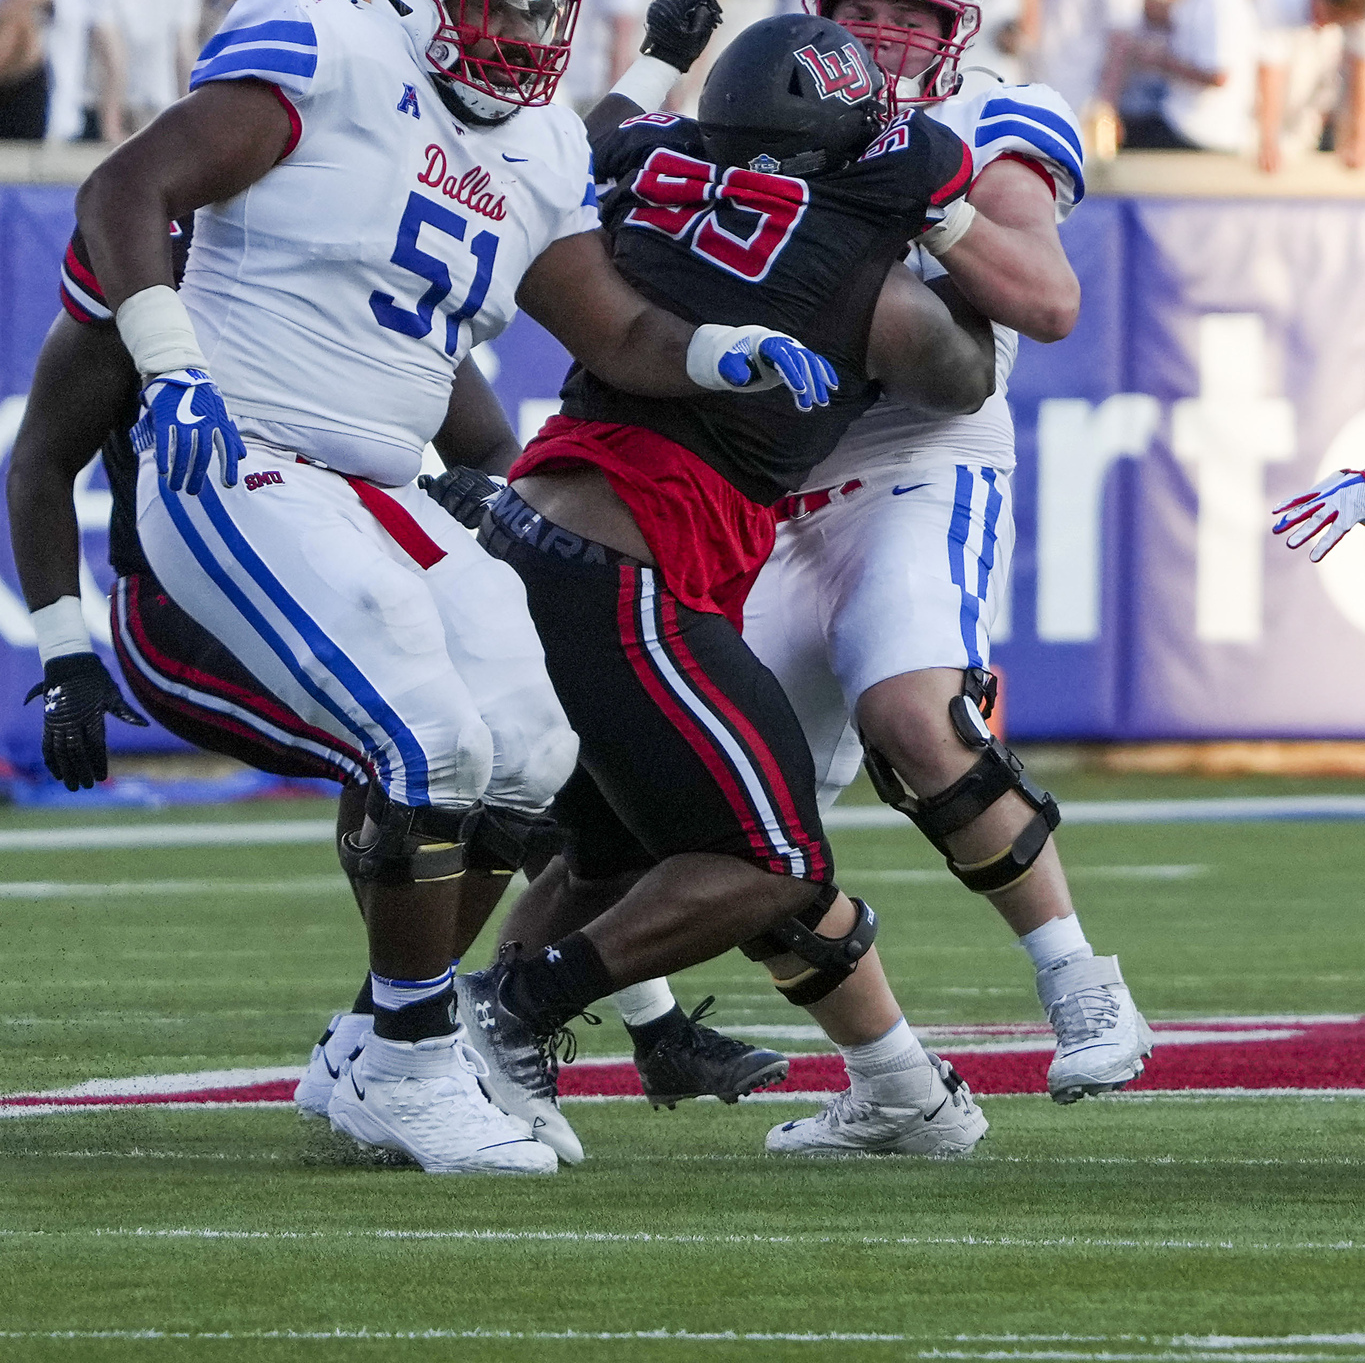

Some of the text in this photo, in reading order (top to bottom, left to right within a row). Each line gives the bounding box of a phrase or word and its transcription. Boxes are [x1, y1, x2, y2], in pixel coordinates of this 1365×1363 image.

[793, 43, 873, 105] LU
[417, 143, 507, 222] Dallas
[368, 190, 500, 356] 51
[244, 471, 283, 491] SMU
